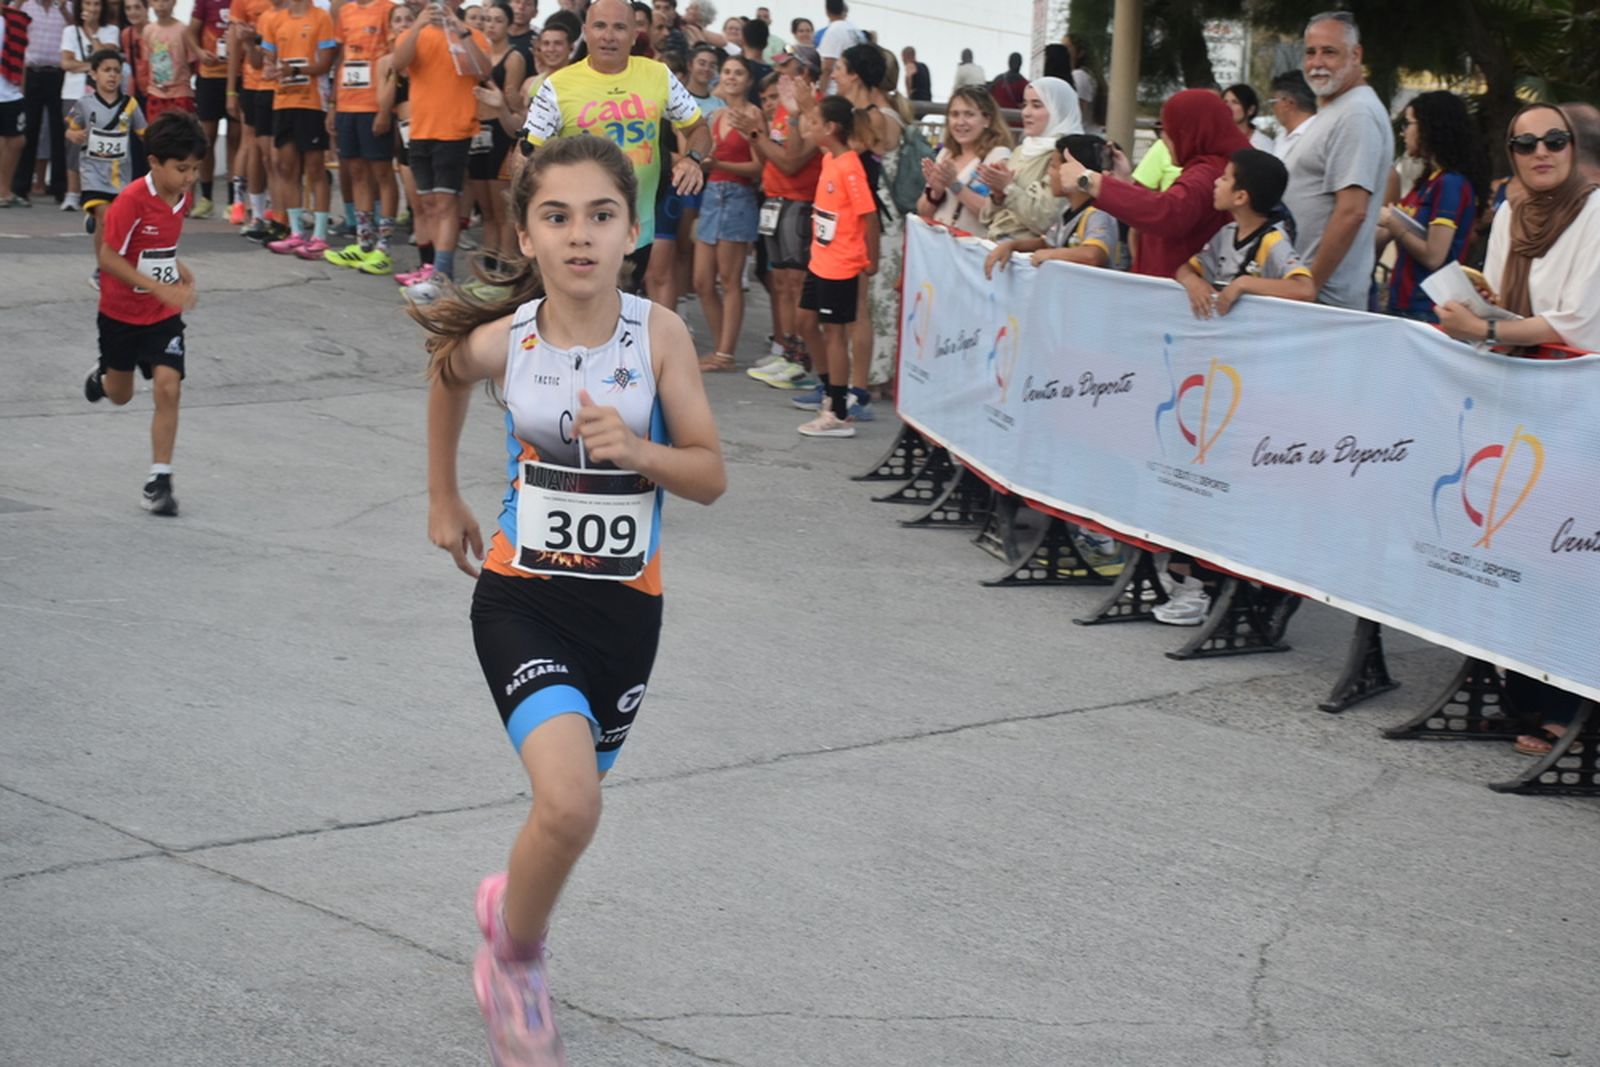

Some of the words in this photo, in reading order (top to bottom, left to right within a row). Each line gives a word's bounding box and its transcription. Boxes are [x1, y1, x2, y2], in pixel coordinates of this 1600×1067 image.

[97, 140, 122, 153] 324
[534, 374, 561, 386] TACTIC
[1022, 375, 1059, 402] Ceuta
[1078, 370, 1136, 408] Deporte
[1252, 435, 1308, 467] Ceuta
[1308, 448, 1328, 465] es
[1333, 434, 1415, 478] Deporte
[545, 510, 637, 556] 309
[1551, 516, 1600, 553] Ceut
[505, 664, 569, 696] BALEARIA
